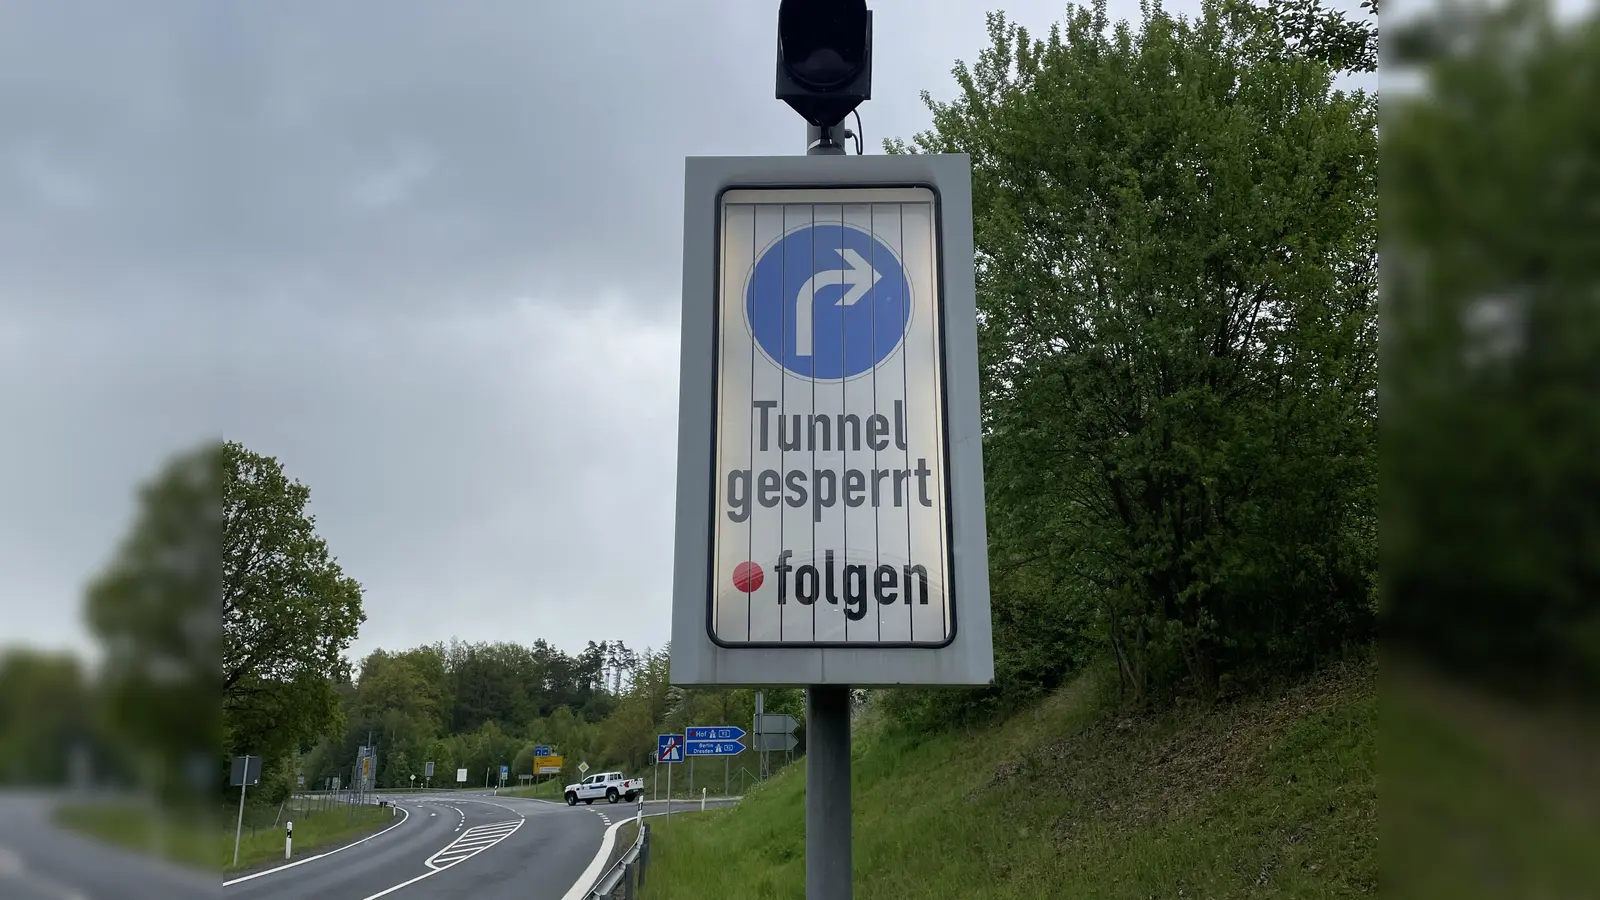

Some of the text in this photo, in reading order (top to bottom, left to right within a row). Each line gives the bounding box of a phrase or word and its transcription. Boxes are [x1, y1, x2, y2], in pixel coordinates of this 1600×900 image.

[753, 399, 908, 452] Tunnel
[727, 458, 932, 523] gesperrt
[774, 550, 929, 622] folgen
